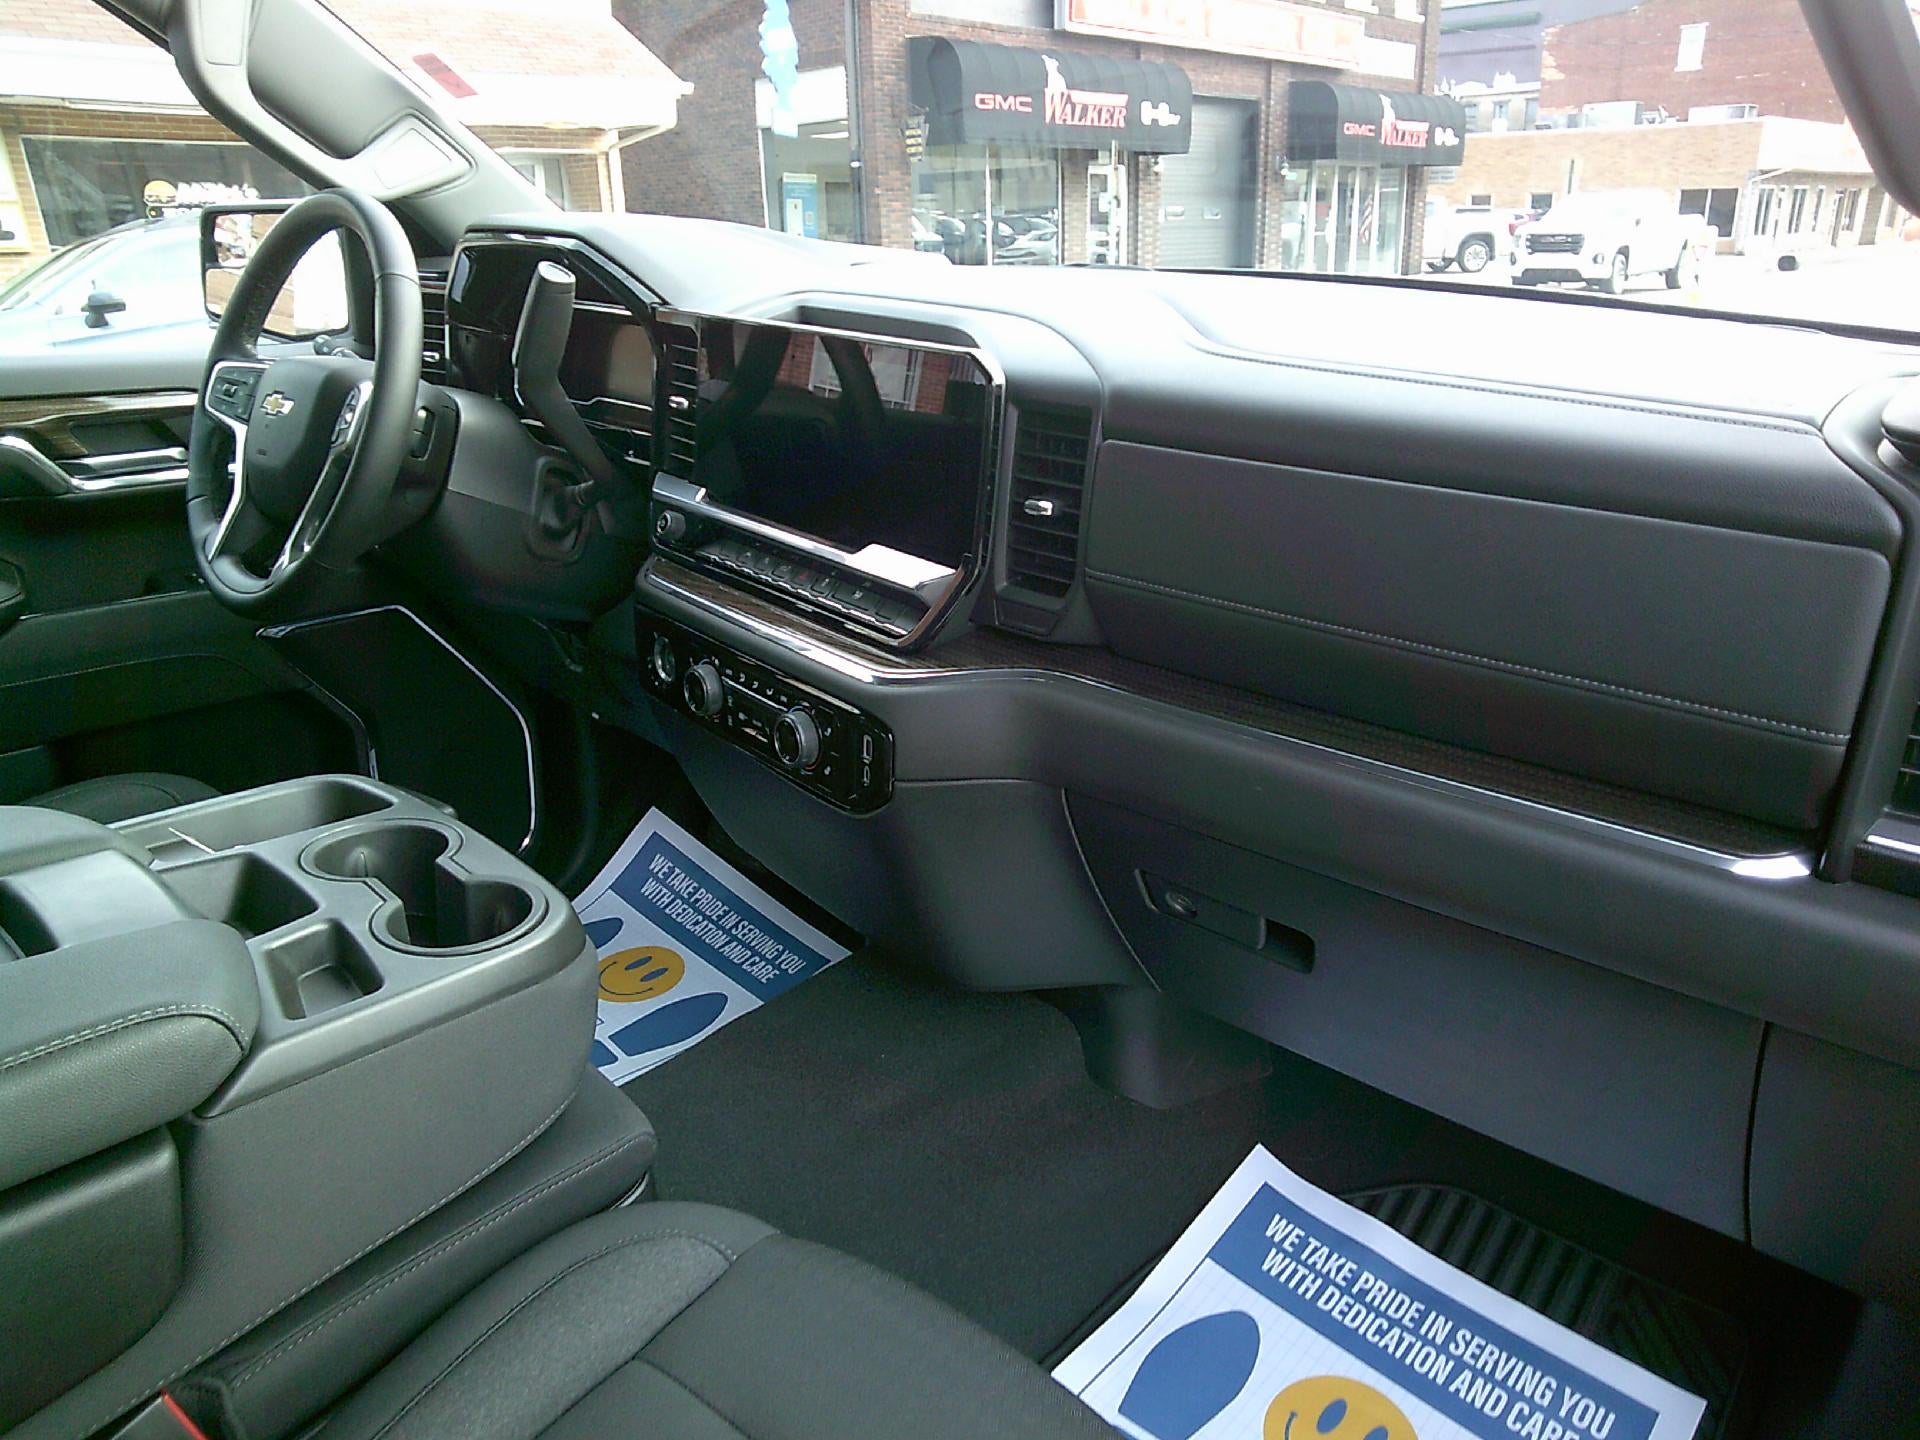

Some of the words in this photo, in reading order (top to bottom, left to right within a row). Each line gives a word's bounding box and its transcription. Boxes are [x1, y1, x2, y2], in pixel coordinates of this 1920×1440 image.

[974, 93, 1033, 113] GMC
[1044, 87, 1128, 129] WALKER
[1343, 121, 1376, 137] GMC
[1379, 118, 1429, 148] WALKER
[640, 877, 675, 909] WITH
[664, 898, 731, 950] DEDICATION
[718, 941, 752, 965] AND
[741, 955, 780, 984] CARE
[649, 853, 674, 879] WE
[666, 866, 699, 899] TAKE
[690, 888, 729, 921] PRIDE
[718, 911, 742, 930] IN
[731, 920, 784, 960] SERVING
[775, 949, 807, 975] YOU
[1261, 1247, 1323, 1301] WITH
[1316, 1284, 1455, 1386] DEDICATION
[1448, 1368, 1509, 1419] AND
[1265, 1212, 1306, 1253] WE
[1300, 1236, 1359, 1288] TAKE
[1351, 1270, 1426, 1330] PRIDE
[1419, 1310, 1453, 1346] IN
[1448, 1327, 1558, 1409] SERVING
[1558, 1385, 1616, 1440] YOU
